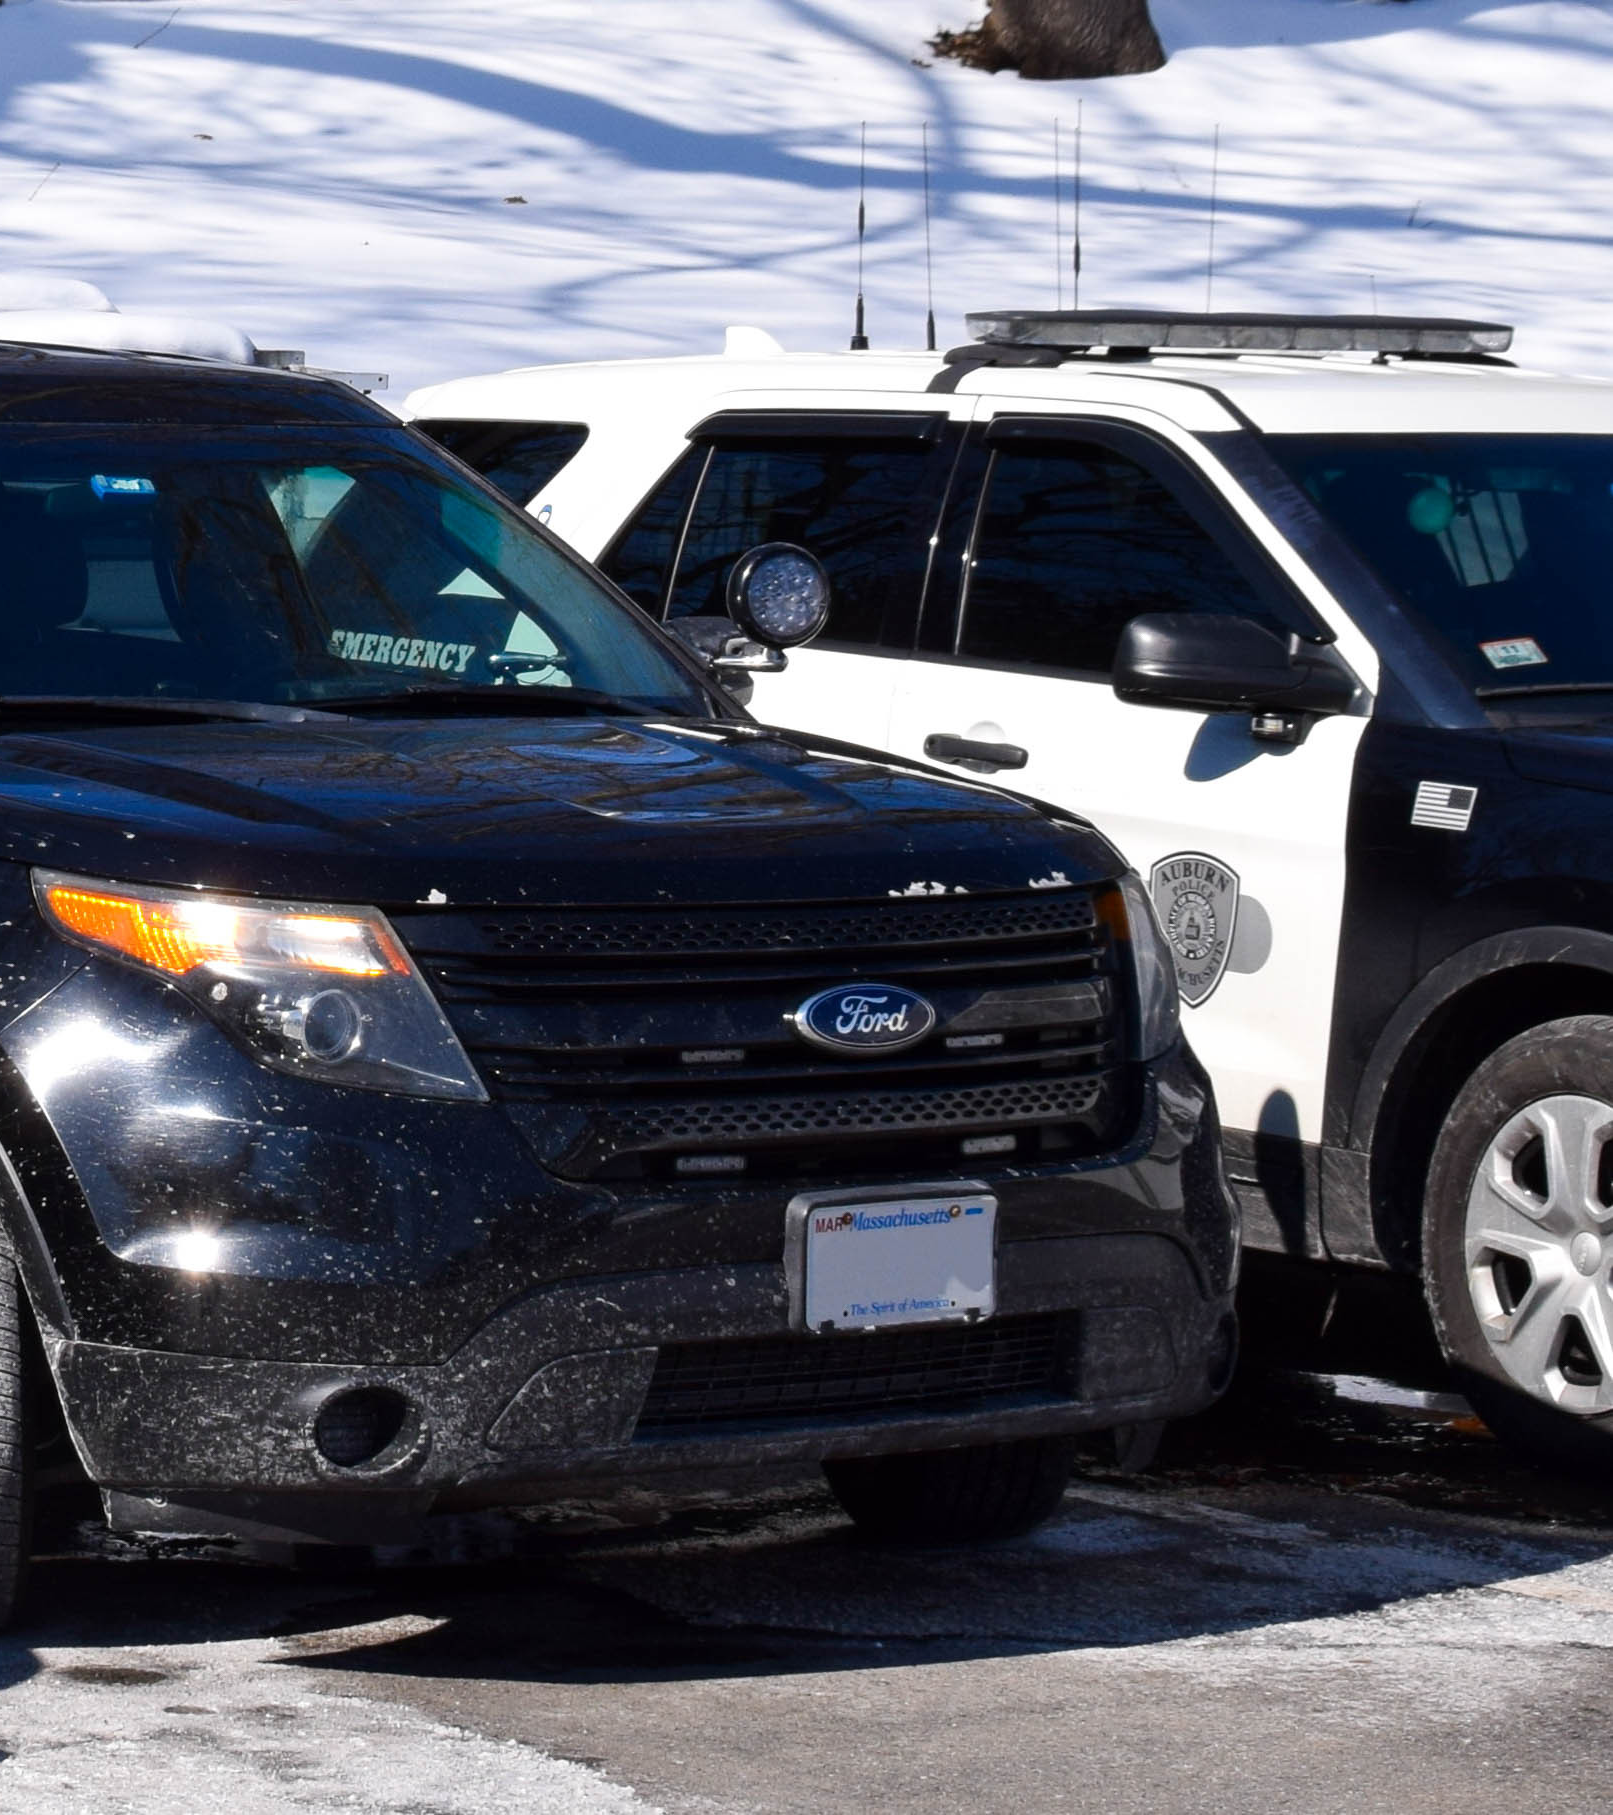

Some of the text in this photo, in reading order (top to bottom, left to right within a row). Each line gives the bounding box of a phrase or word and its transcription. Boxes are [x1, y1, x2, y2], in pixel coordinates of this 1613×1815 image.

[327, 629, 476, 673] EMERGENCY
[1160, 862, 1230, 893] AUBURN
[1172, 879, 1216, 900] POLICE
[836, 995, 908, 1034] Ford
[815, 1207, 951, 1233] MAR Massachusetts
[851, 1303, 869, 1316] The
